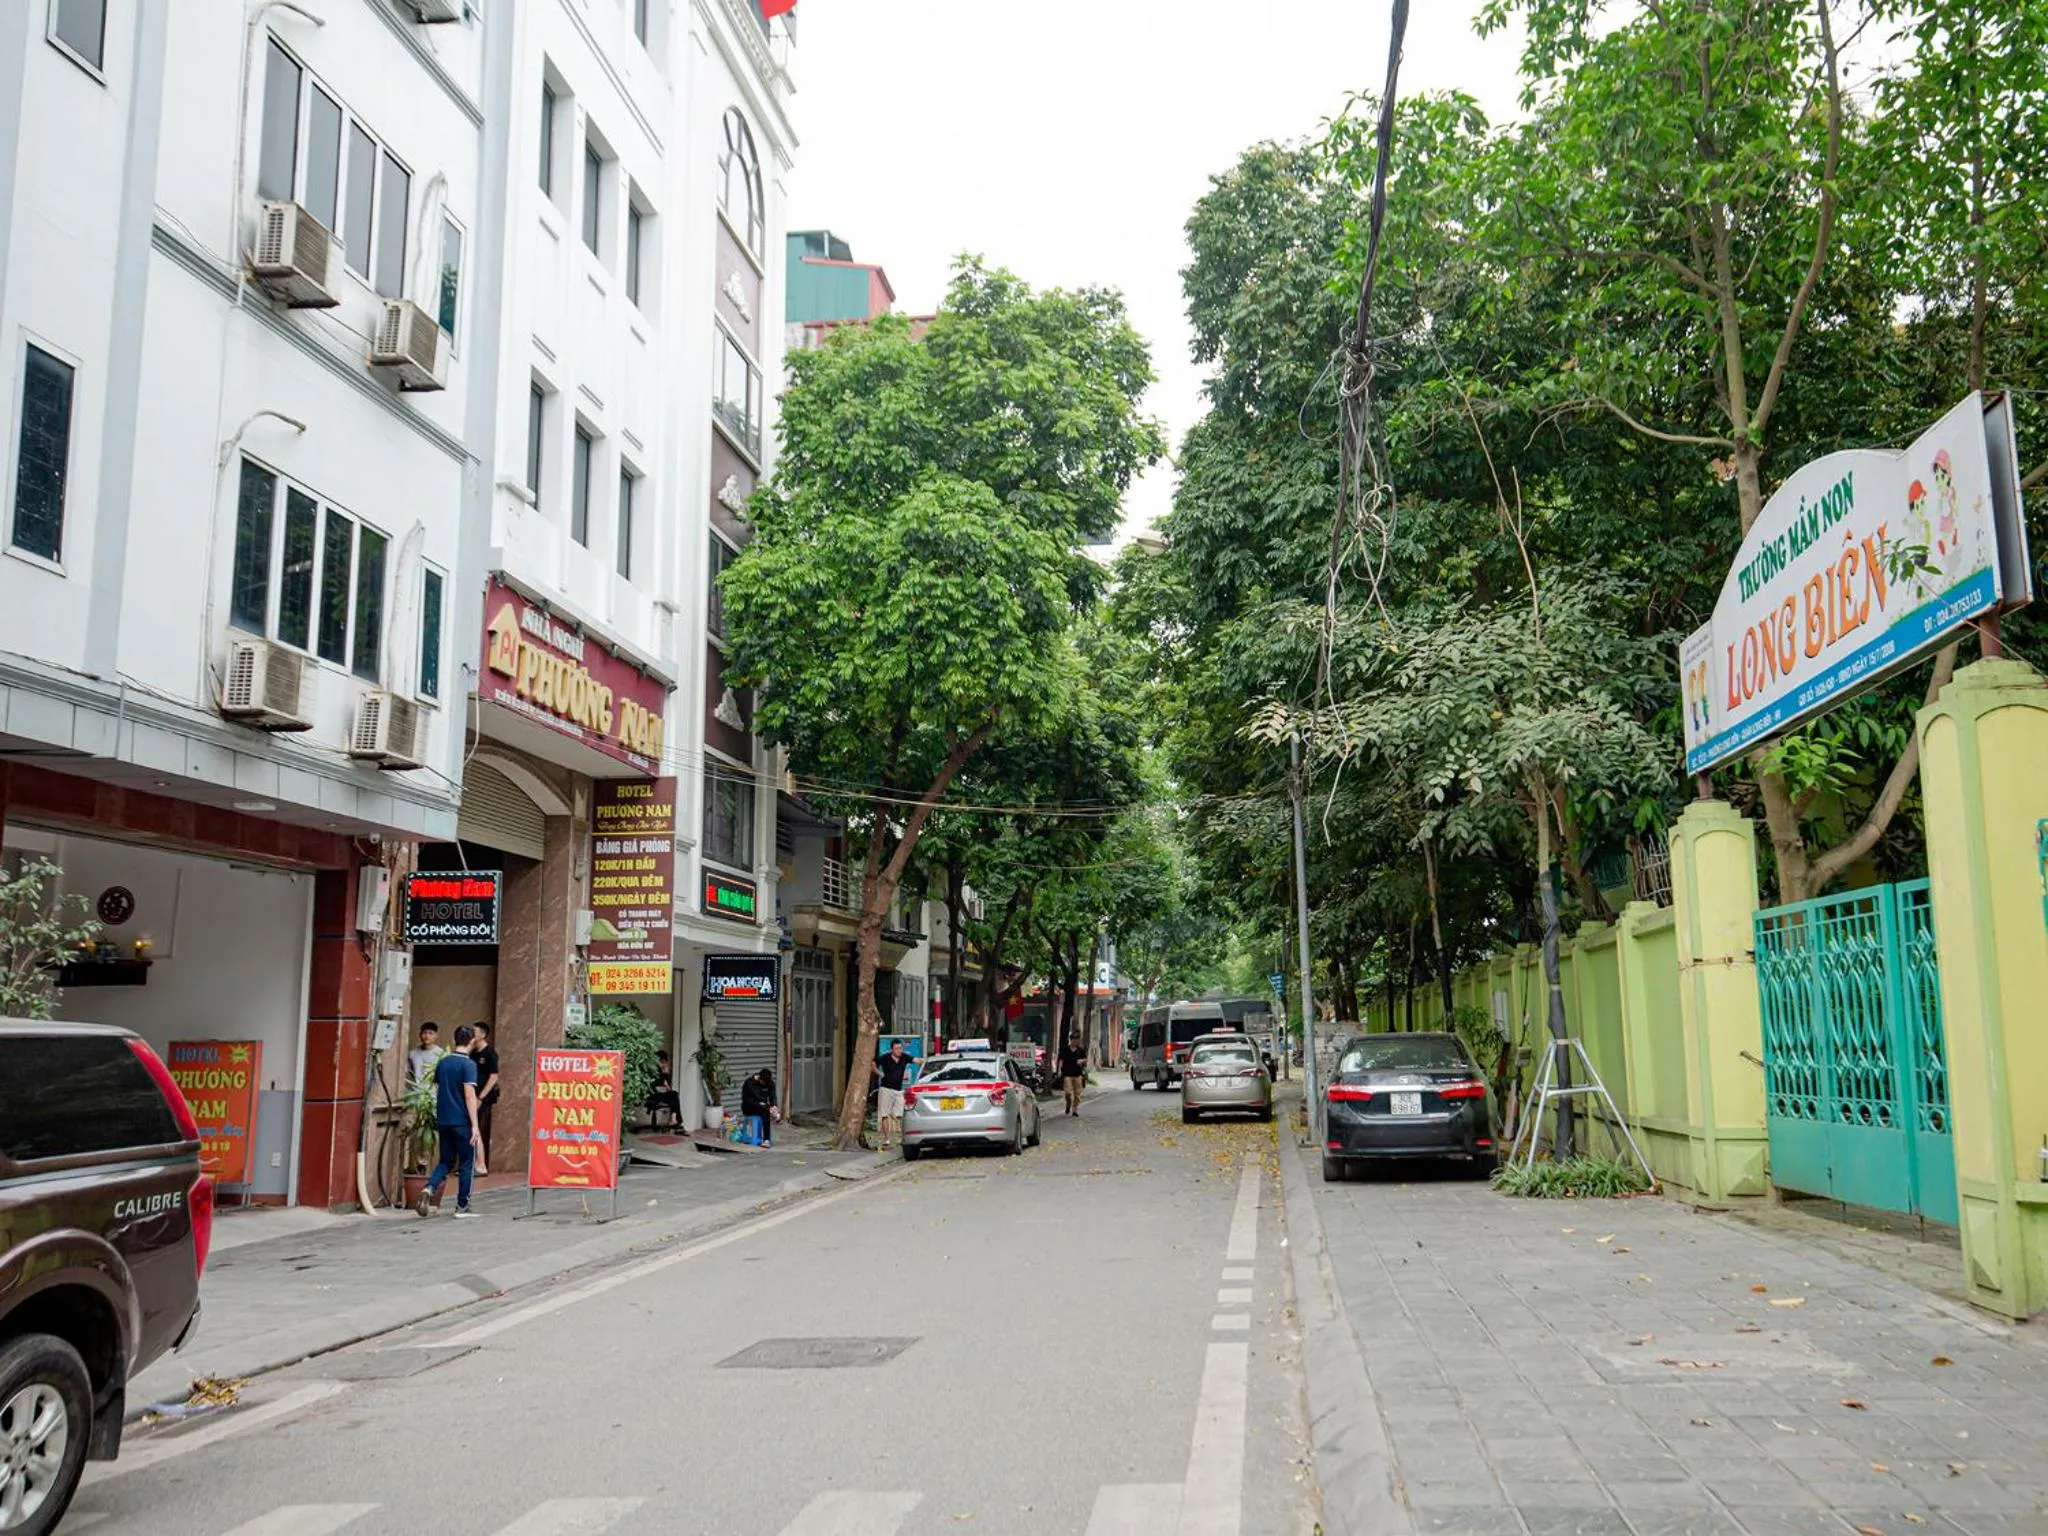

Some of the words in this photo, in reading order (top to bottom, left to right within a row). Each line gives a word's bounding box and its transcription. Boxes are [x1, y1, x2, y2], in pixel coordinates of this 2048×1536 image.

[1737, 534, 1788, 604] TRƯỜNG
[1788, 495, 1820, 562] MẦM
[1820, 470, 1855, 533] NON
[521, 605, 552, 643] NHÀ
[1726, 592, 1797, 712] LONG
[1803, 520, 1888, 659] BIÊN
[619, 697, 665, 761] NAM
[617, 785, 653, 798] HOTEL
[597, 803, 643, 818] PHƯƠNG
[645, 804, 672, 817] NAM
[596, 837, 621, 854] BẢNG
[622, 838, 638, 853] GIÁ
[639, 837, 671, 853] PHÒNG
[593, 876, 640, 888] 220K/QUA
[641, 873, 664, 887] ĐÊM
[648, 891, 670, 905] ĐÊM
[421, 903, 484, 920] HOTEL
[410, 923, 428, 936] CÓ
[429, 923, 468, 935] PHÒNG
[470, 923, 490, 935] ĐÔI
[605, 968, 620, 979] 024
[638, 981, 648, 991] 19
[650, 981, 666, 990] 111
[175, 1047, 222, 1063] HOTEL
[540, 1056, 591, 1072] HOTEL
[172, 1067, 246, 1089] PHƯƠNG
[537, 1080, 613, 1101] PHƯƠNG
[553, 1107, 595, 1126] NAM
[114, 1192, 182, 1218] CALIBRE
